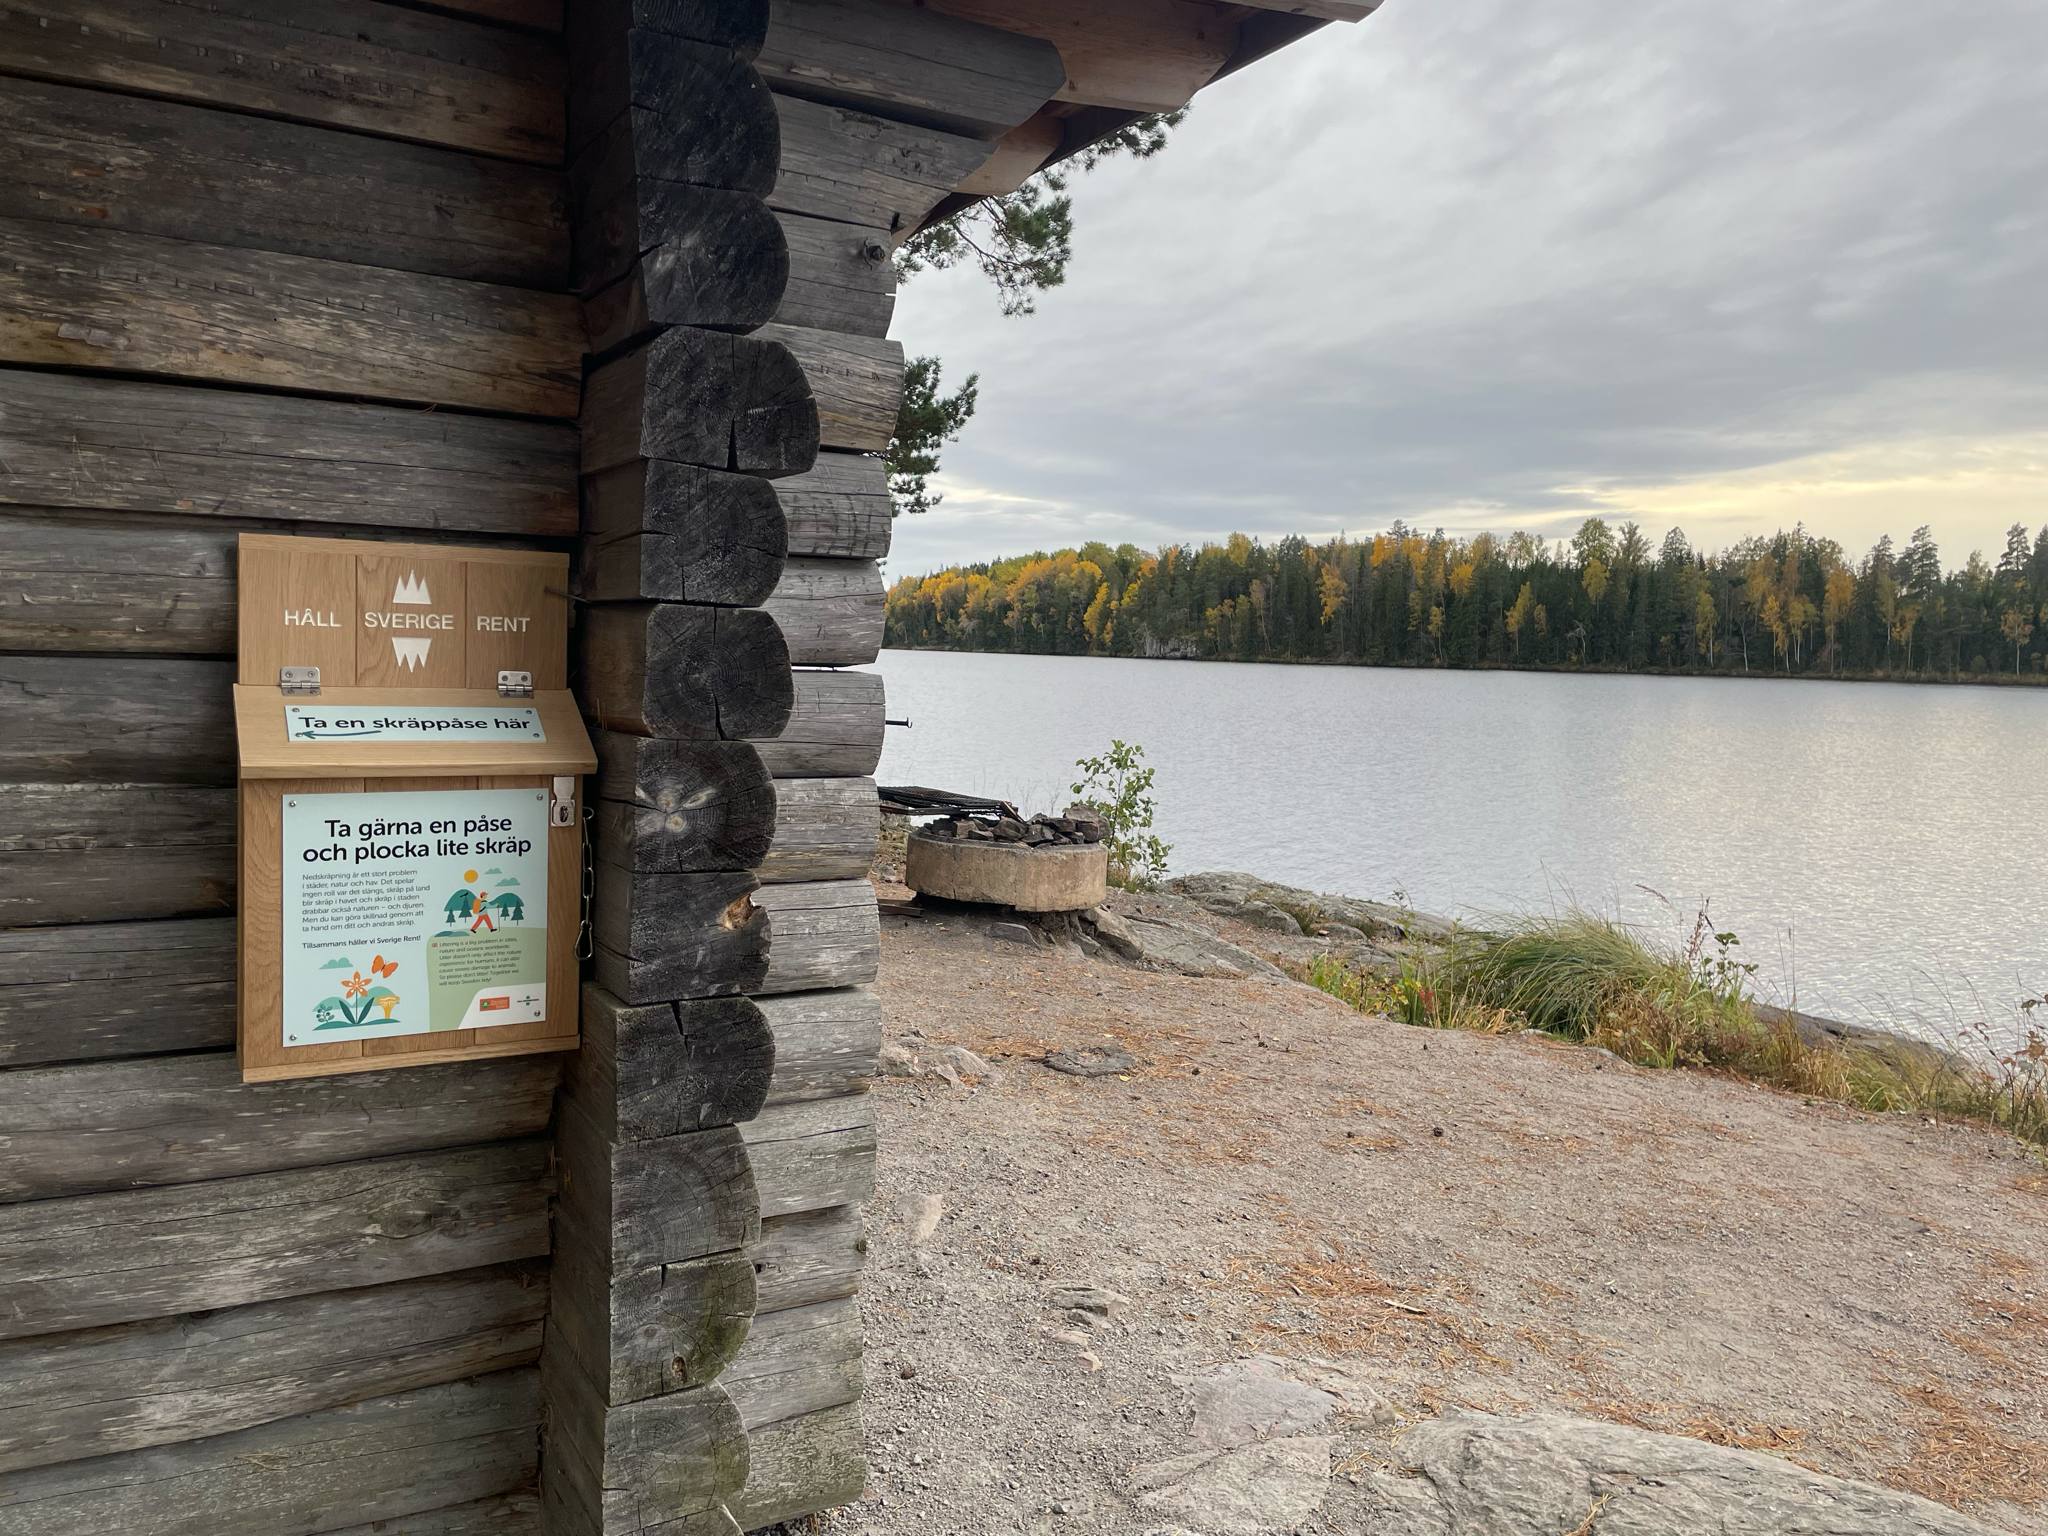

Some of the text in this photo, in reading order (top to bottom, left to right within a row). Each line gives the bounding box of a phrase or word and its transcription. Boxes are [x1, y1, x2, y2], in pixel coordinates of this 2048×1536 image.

[284, 609, 530, 632] HÅLL SVERIGE RENT
[298, 716, 530, 731] Ta en skräppåse här
[325, 815, 512, 841] Ta gärna en påse
[303, 837, 531, 864] och plocka lite skräp
[302, 872, 350, 881] Nedskräpning
[352, 870, 359, 878] är
[388, 869, 417, 877] problem
[302, 890, 322, 898] ingen
[337, 888, 347, 896] var
[386, 886, 404, 894] skräp
[315, 898, 333, 906] skräp
[339, 896, 357, 904] havet
[302, 906, 329, 914] drabbar
[353, 904, 379, 912] naturen
[345, 914, 361, 922] göra
[389, 911, 413, 919] genom
[372, 919, 395, 927] andras
[302, 941, 346, 949] Tillsammans
[377, 936, 402, 944] Sverige
